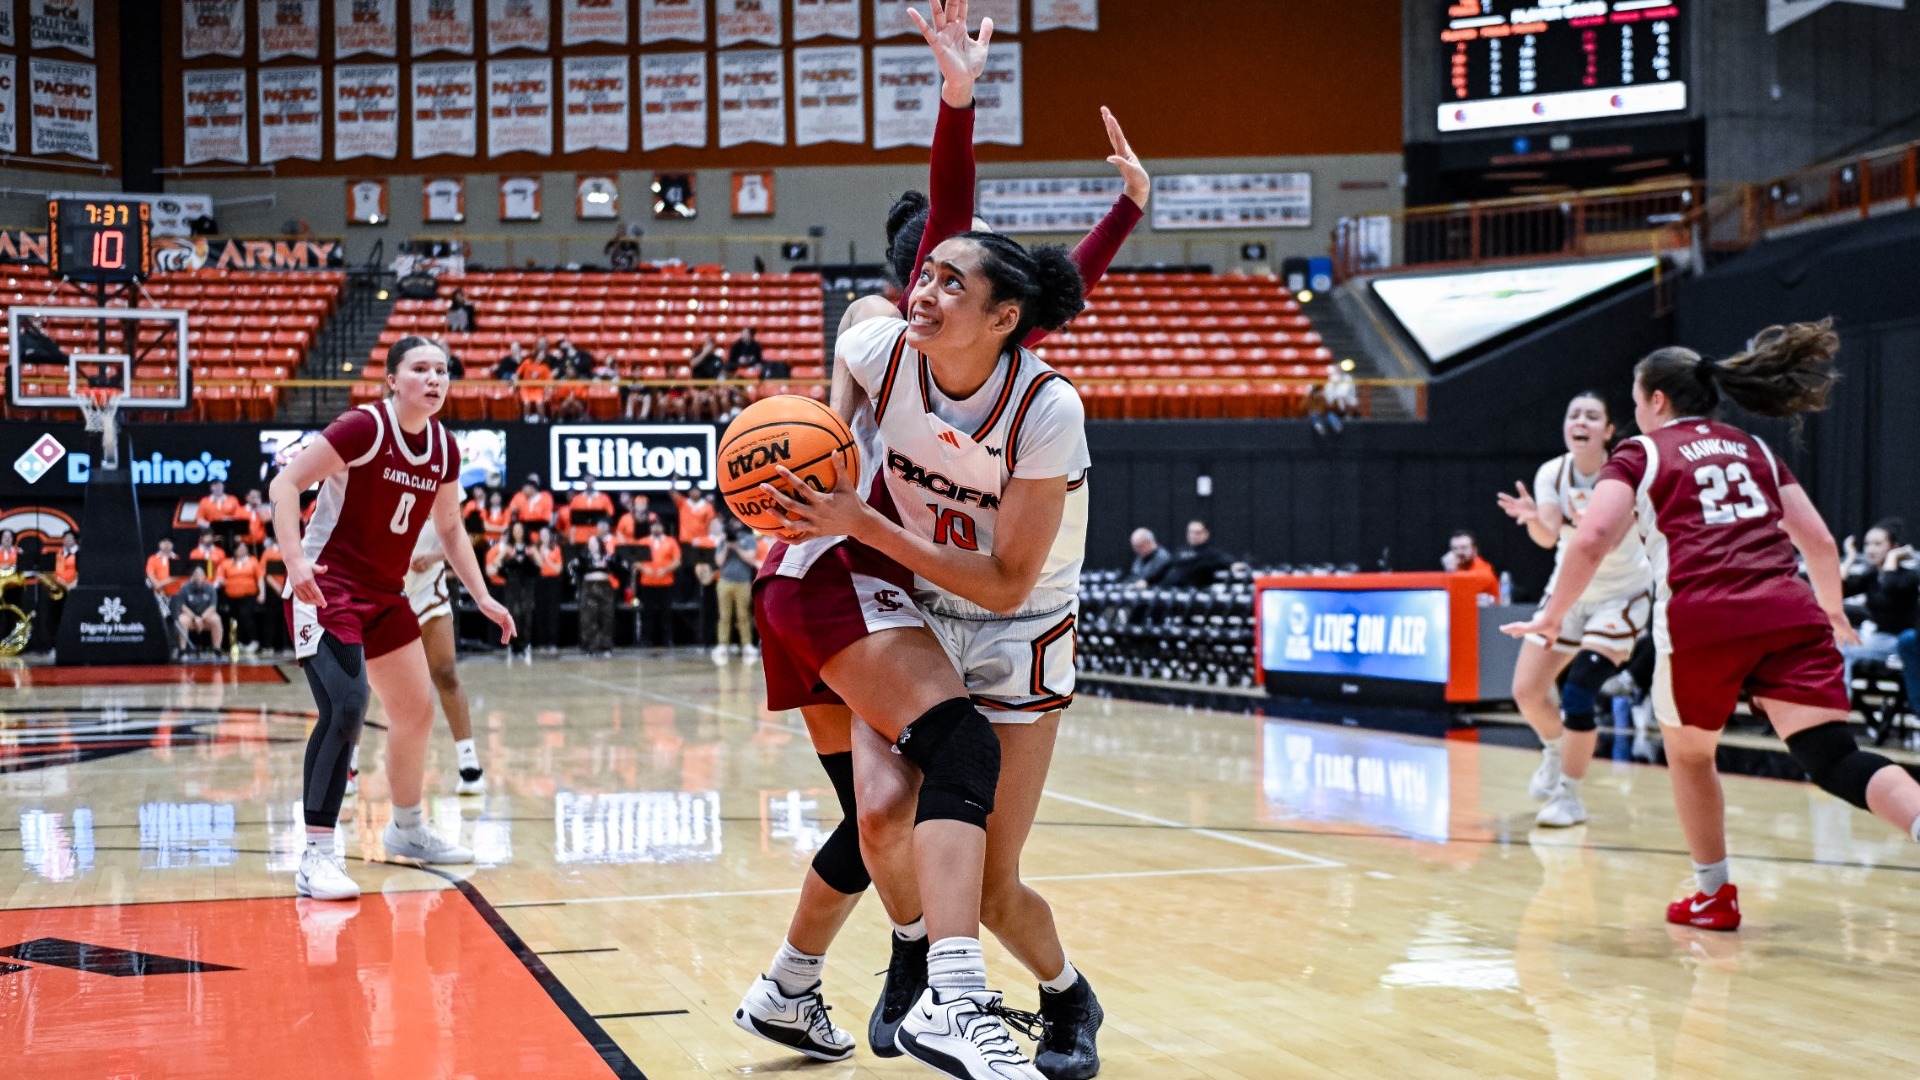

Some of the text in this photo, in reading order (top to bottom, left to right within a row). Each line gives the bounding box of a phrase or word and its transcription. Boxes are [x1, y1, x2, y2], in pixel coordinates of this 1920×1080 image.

[34, 63, 90, 77] UNIVERSITY
[724, 71, 777, 86] PACIFIC
[803, 68, 855, 82] PACIFIC
[881, 72, 935, 86] PACIFIC
[974, 69, 1014, 84] CIFIC
[33, 79, 91, 99] PACIFIC
[492, 80, 546, 95] PACIFIC
[569, 78, 623, 92] PACIFIC
[646, 74, 700, 88] PACIFIC
[188, 90, 242, 104] PACIFIC
[263, 87, 317, 102] PACIFIC
[339, 84, 394, 99] PACIFIC
[417, 83, 472, 98] PACIFIC
[33, 104, 93, 122] BIG WEST
[85, 204, 129, 226] 7:37
[92, 230, 124, 268] 10
[216, 239, 335, 268] ARMY
[564, 438, 703, 477] Hilton
[727, 438, 791, 480] NCAA
[1678, 438, 1748, 462] HAWKINS
[67, 451, 228, 484] Dmino's
[383, 467, 410, 486] SANTA
[411, 475, 437, 492] CLARA
[1693, 461, 1770, 525] 23
[389, 491, 417, 536] 0
[926, 503, 979, 551] 10
[80, 622, 146, 635] Dignity Health
[1313, 613, 1356, 653] LIVE
[1356, 614, 1386, 655] ON
[1387, 615, 1427, 656] AIR
